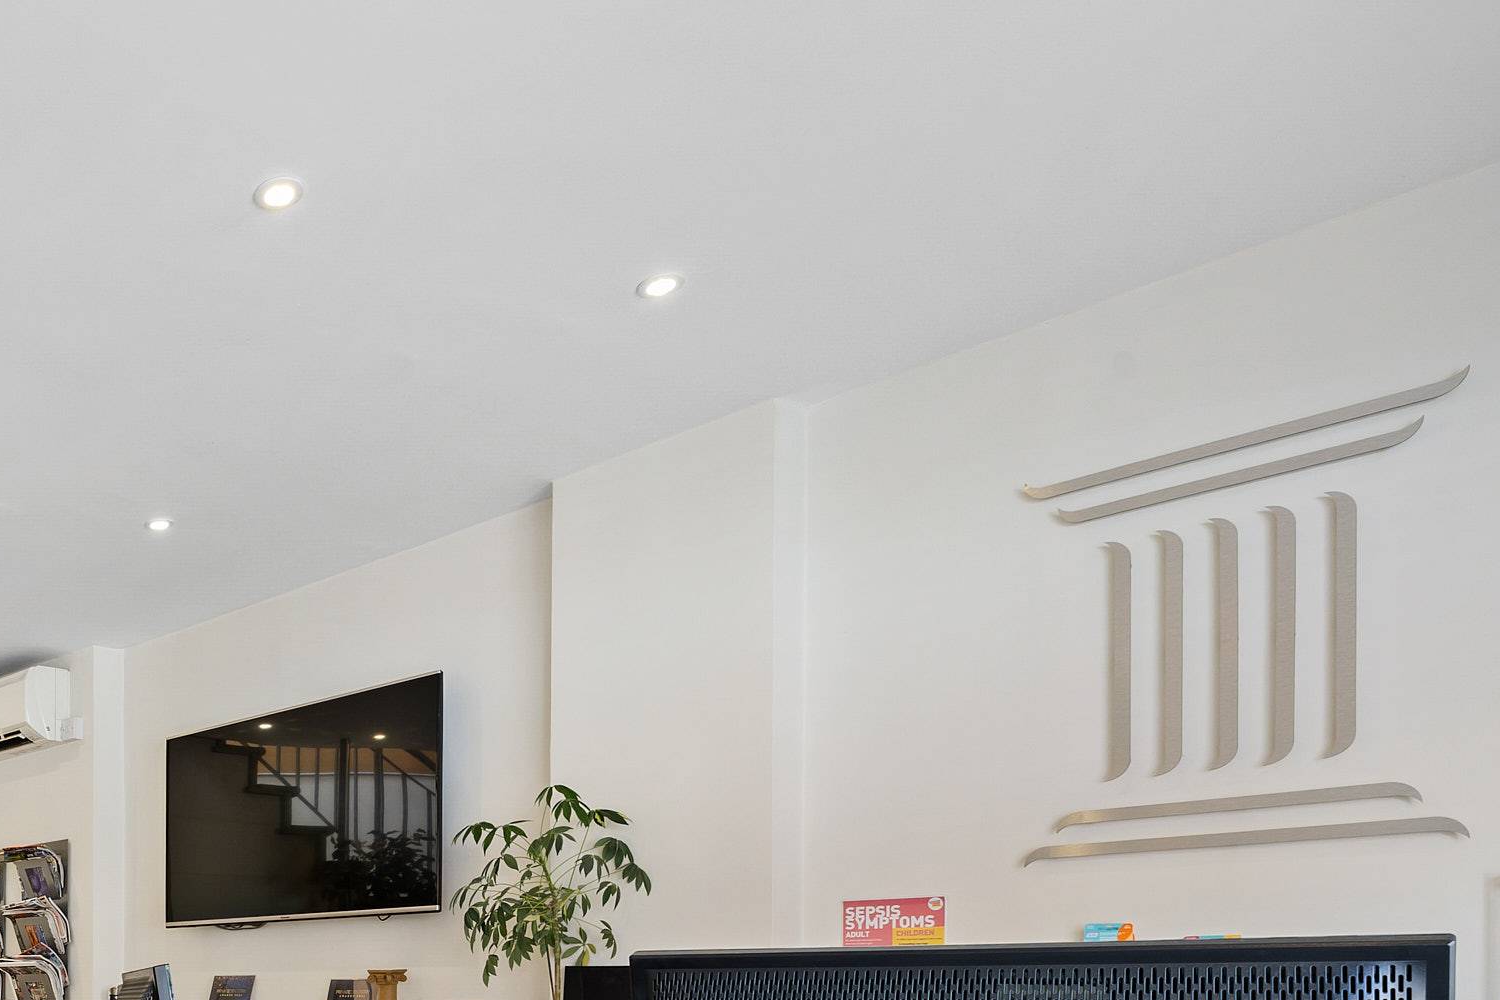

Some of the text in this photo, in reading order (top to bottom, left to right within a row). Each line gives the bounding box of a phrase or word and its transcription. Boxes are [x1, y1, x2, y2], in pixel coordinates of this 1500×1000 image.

[845, 905, 901, 920] SEPSIS
[845, 914, 935, 930] SYMPTOMS
[845, 930, 870, 938] ADULT
[896, 929, 935, 937] CHILDREN
